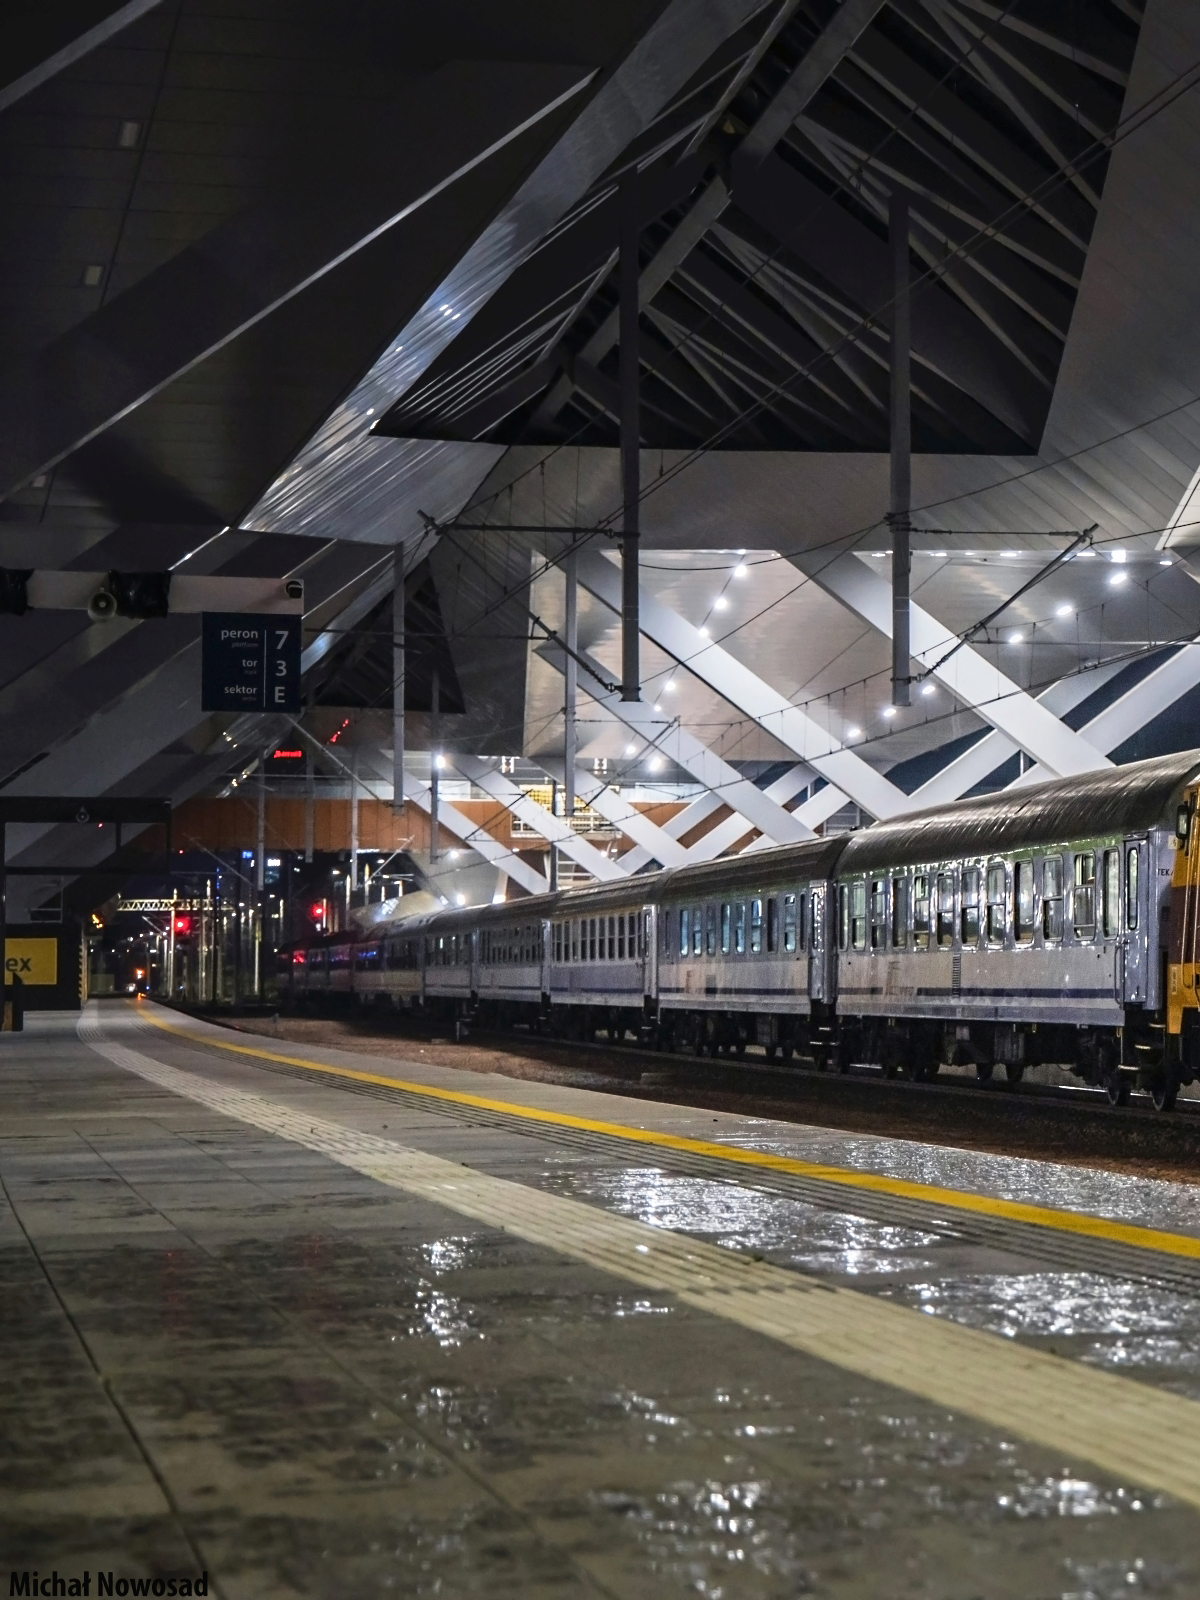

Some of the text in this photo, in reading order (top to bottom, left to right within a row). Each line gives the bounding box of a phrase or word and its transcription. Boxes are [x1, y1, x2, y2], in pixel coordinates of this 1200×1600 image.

[221, 629, 289, 650] peron 7
[242, 659, 287, 677] tor 3
[224, 684, 286, 703] sektor E
